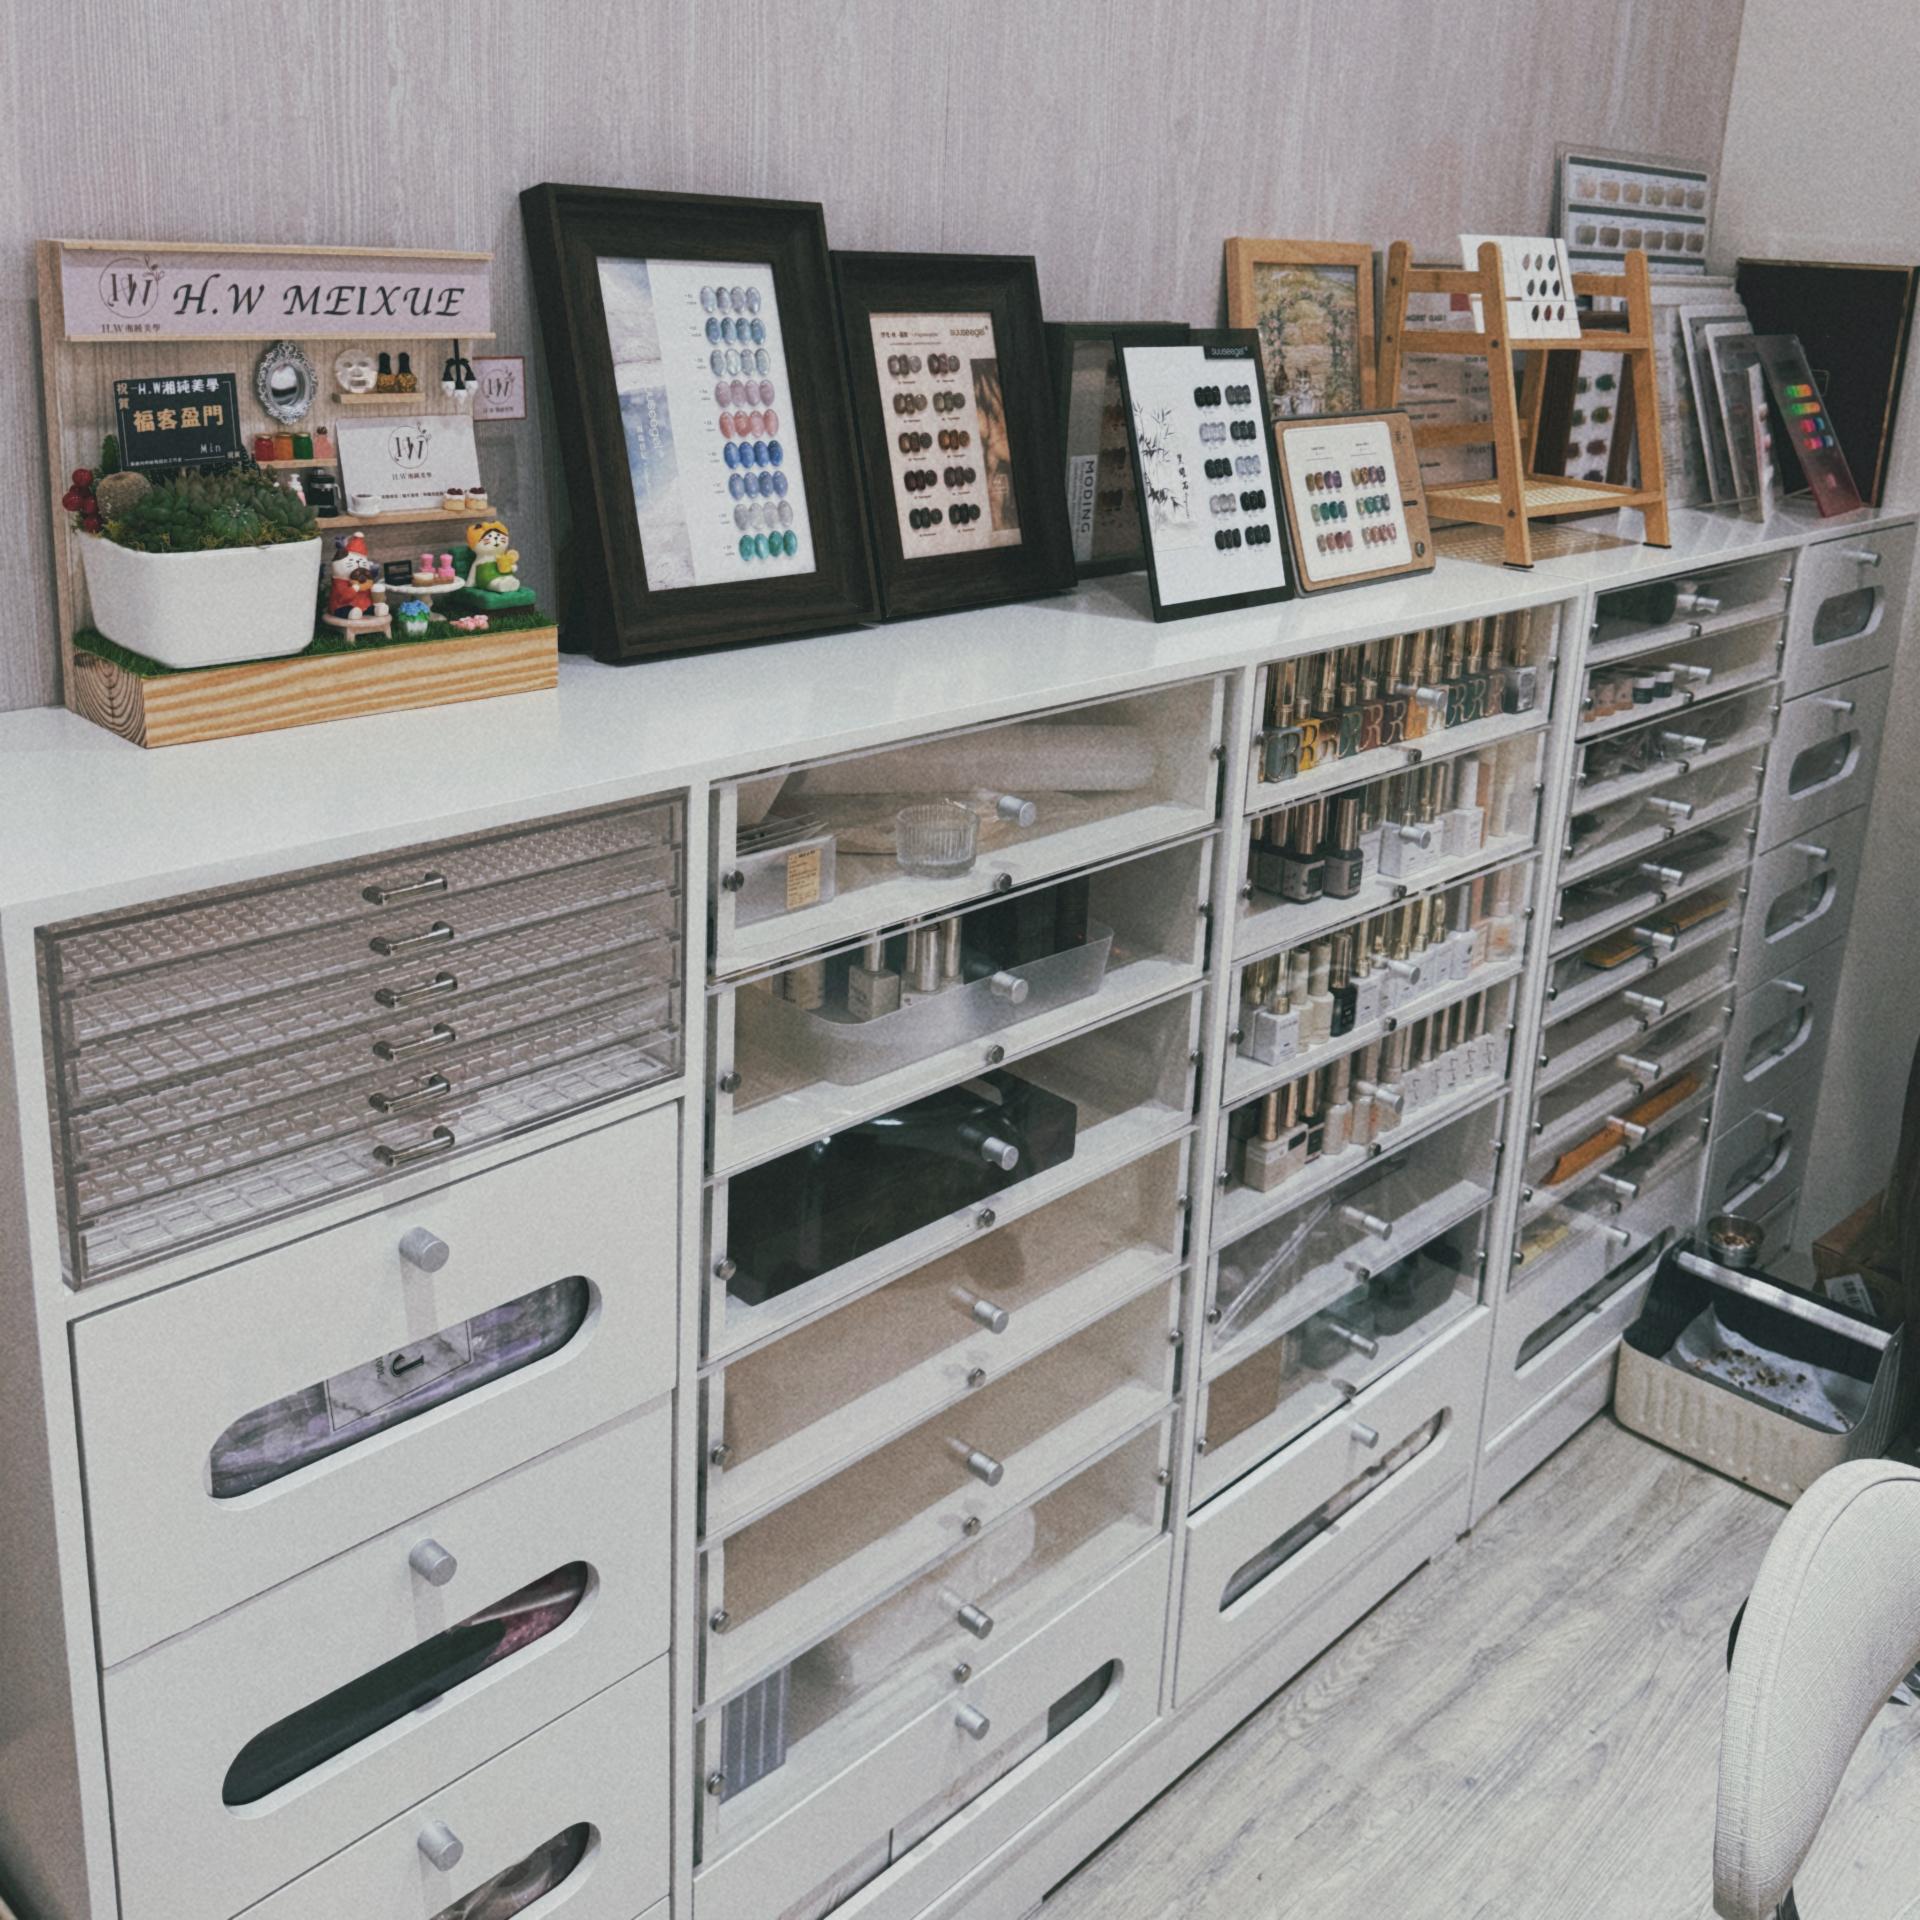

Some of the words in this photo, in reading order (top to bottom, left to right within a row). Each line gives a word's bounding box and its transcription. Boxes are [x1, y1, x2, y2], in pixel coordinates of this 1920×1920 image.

[173, 273, 265, 315] H.W
[283, 284, 465, 316] MEIXUE
[133, 404, 224, 433] 福客盈門
[1081, 460, 1095, 533] MODING
[391, 1353, 424, 1377] J
